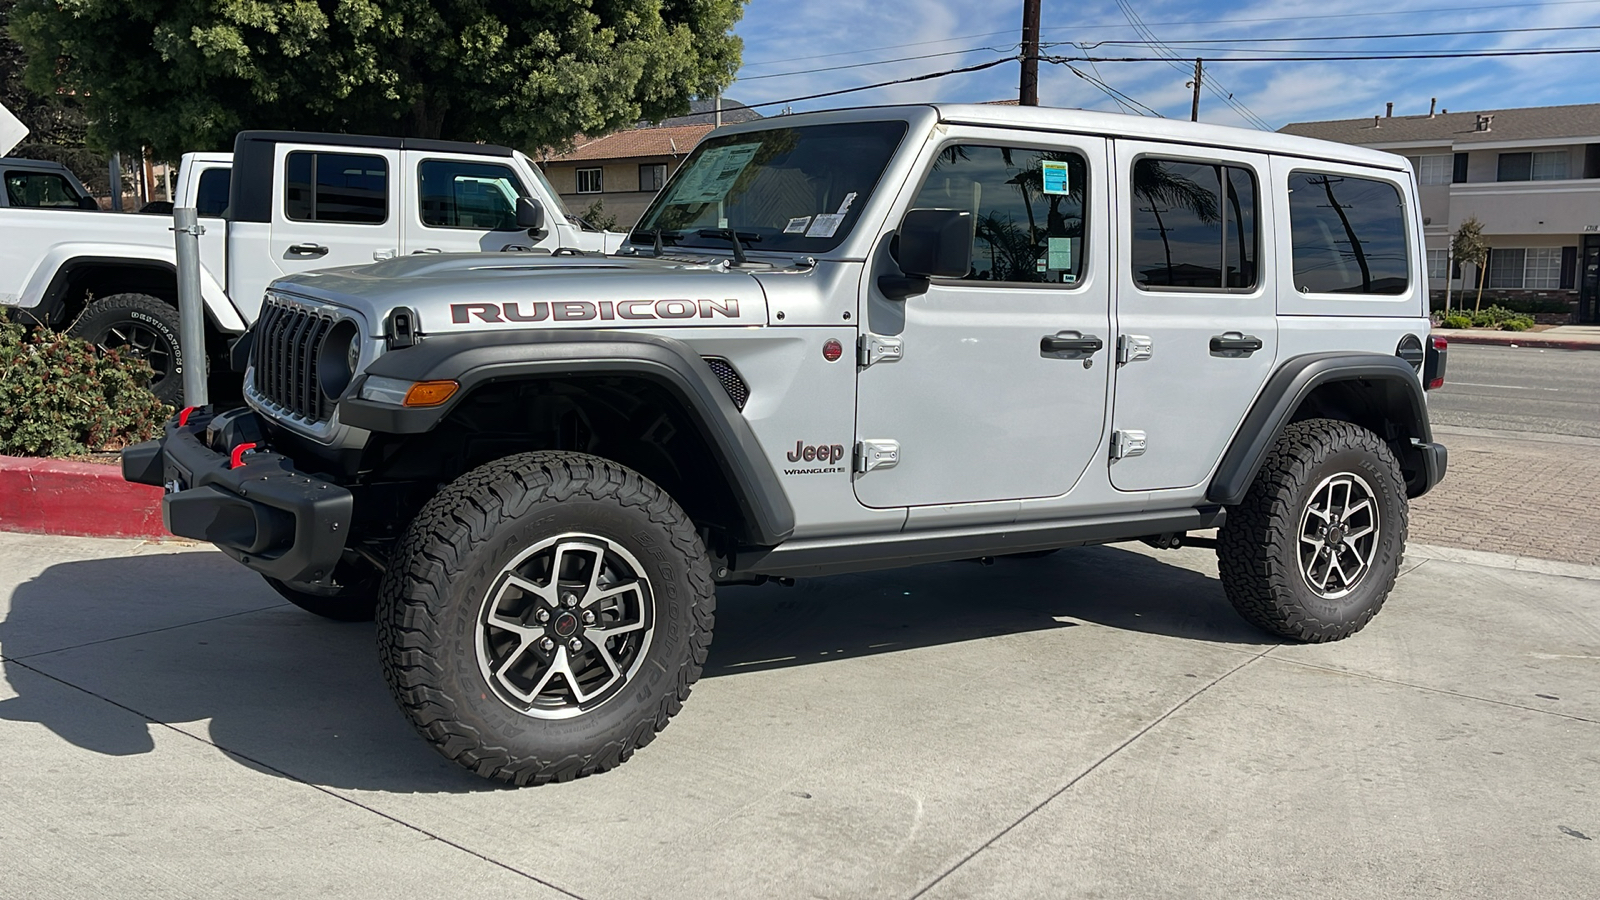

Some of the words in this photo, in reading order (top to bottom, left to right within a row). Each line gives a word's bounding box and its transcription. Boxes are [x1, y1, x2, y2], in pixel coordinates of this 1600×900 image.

[450, 299, 740, 324] RUBICON
[131, 312, 182, 366] DESTINATION
[787, 440, 844, 465] Jeep
[783, 467, 836, 475] WRANGLER
[631, 531, 680, 704] BFGoodrich
